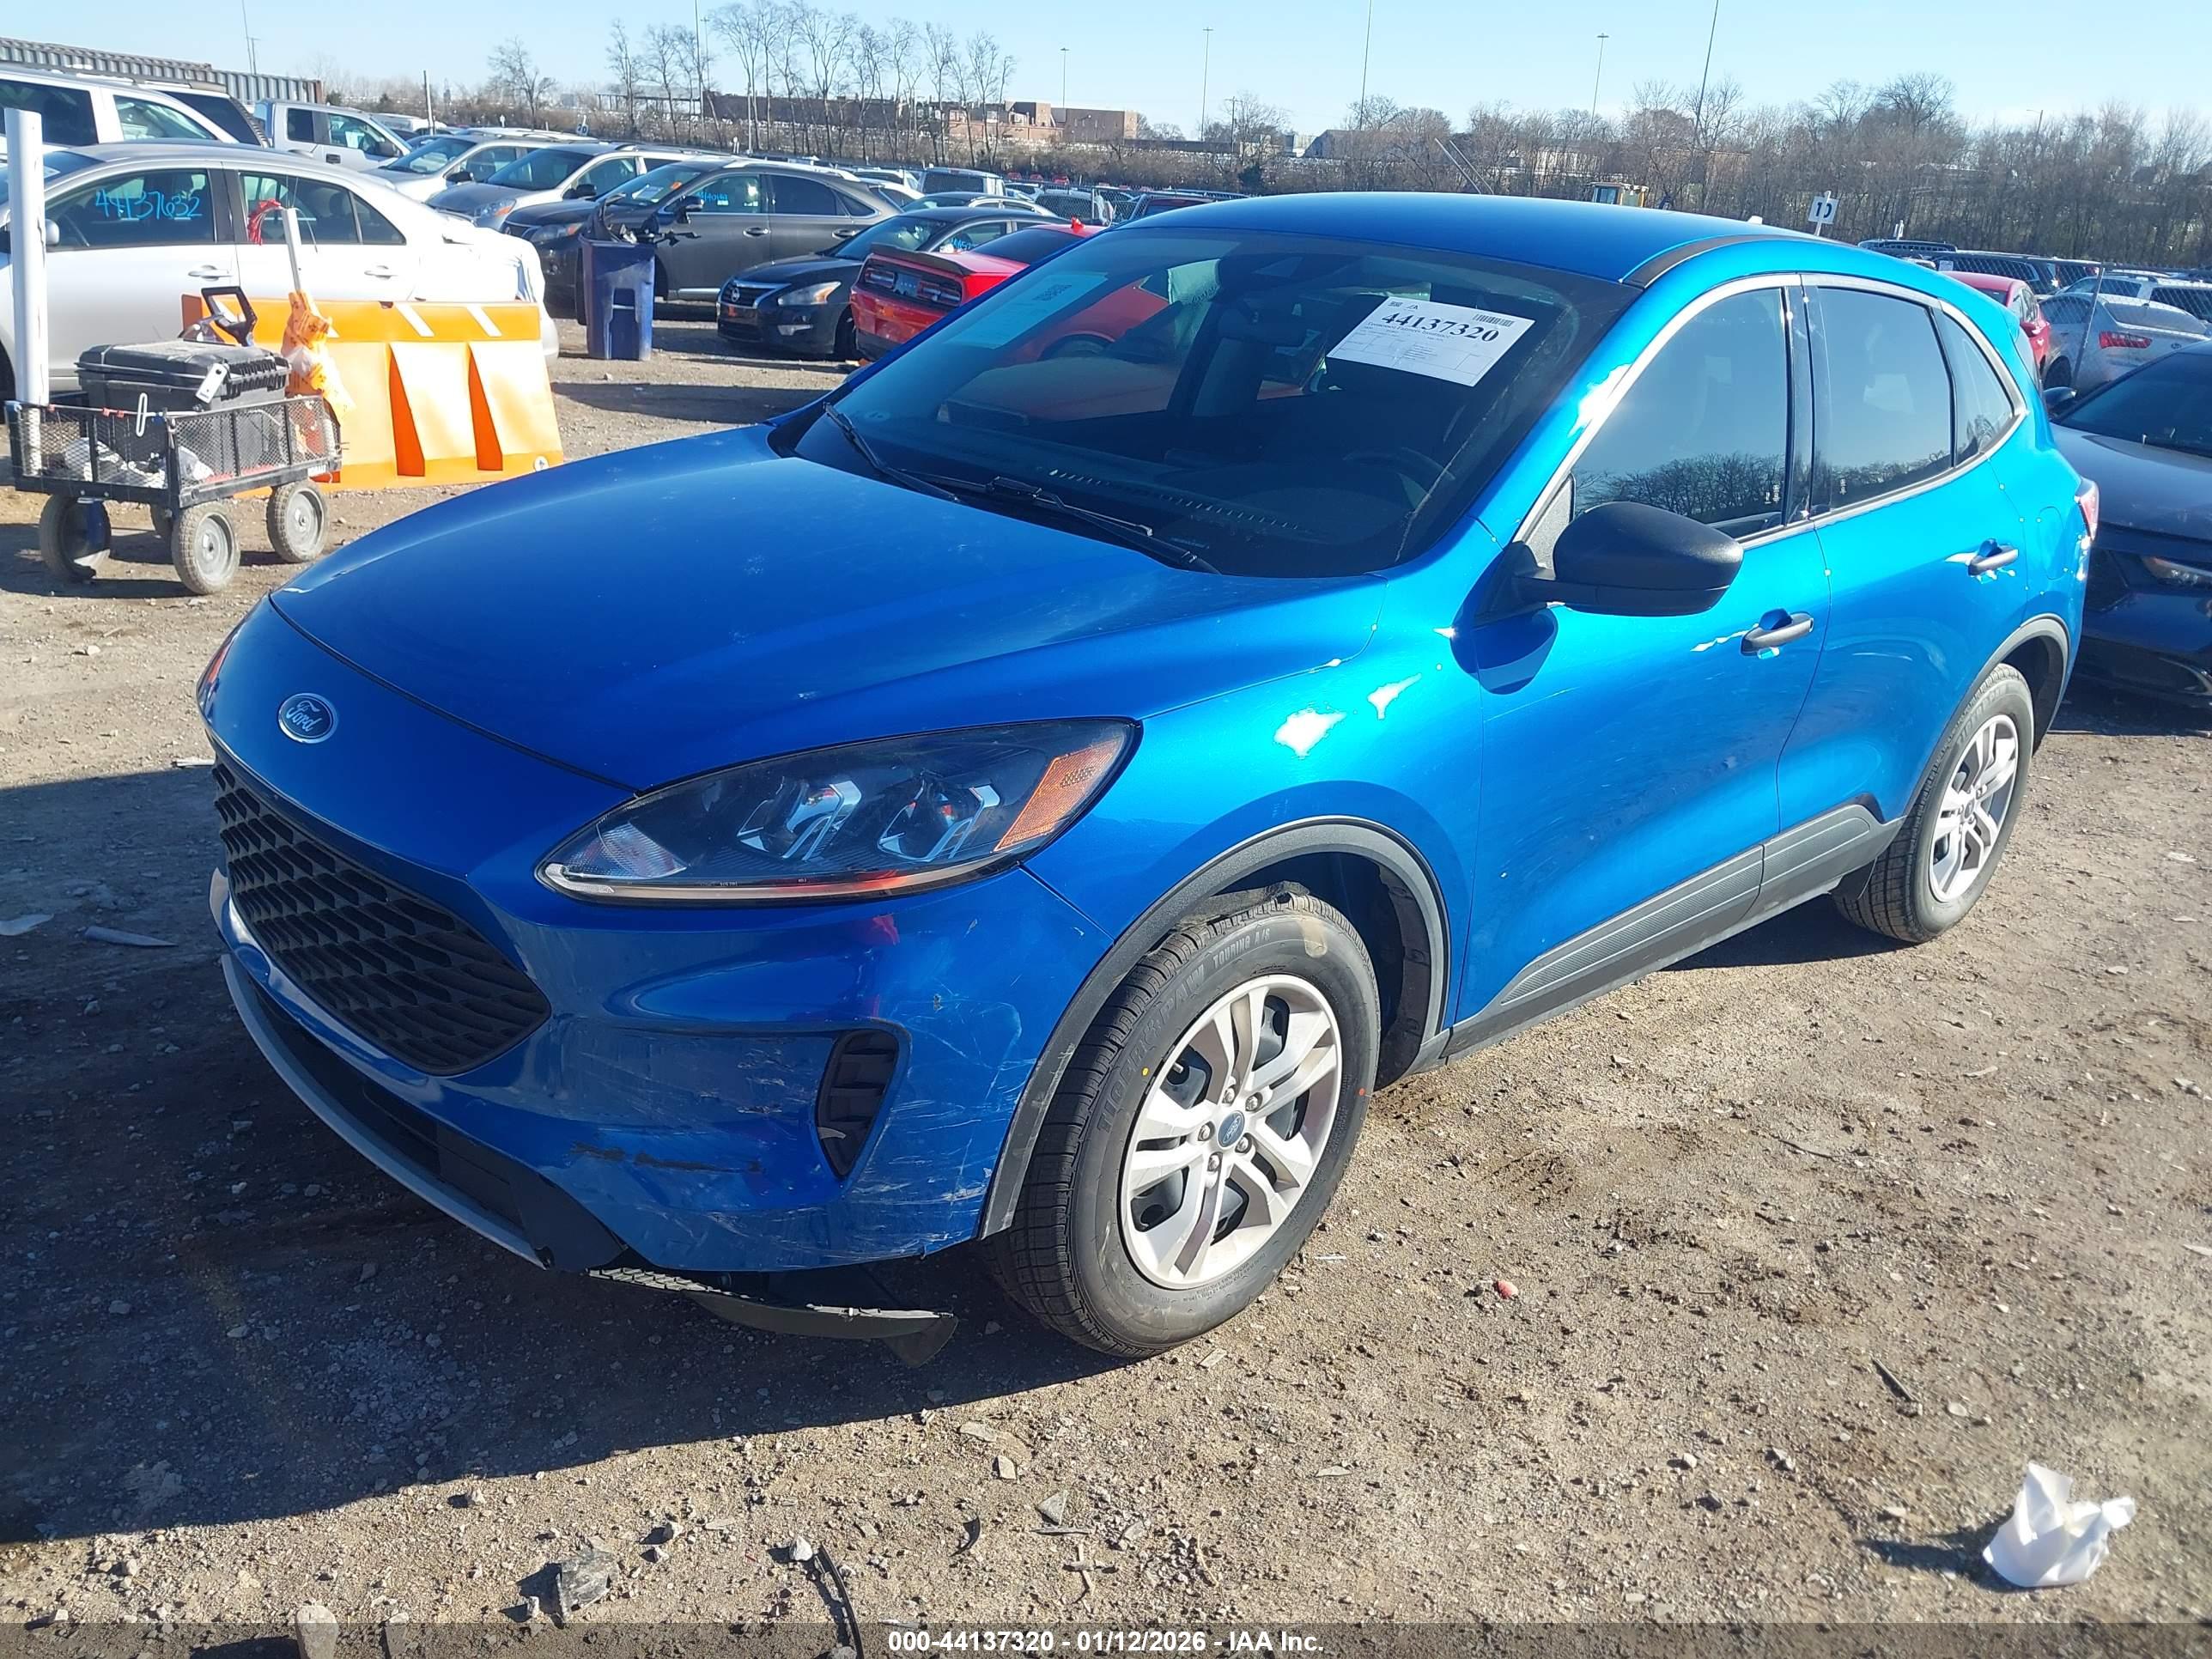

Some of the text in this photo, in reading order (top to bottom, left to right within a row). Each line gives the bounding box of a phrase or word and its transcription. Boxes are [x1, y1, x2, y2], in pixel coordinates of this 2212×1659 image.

[95, 187, 203, 220] 44137632
[1381, 312, 1500, 343] 44137320
[286, 701, 322, 732] Ford
[1094, 926, 1272, 1133] TIGER PAW TOURING A/S
